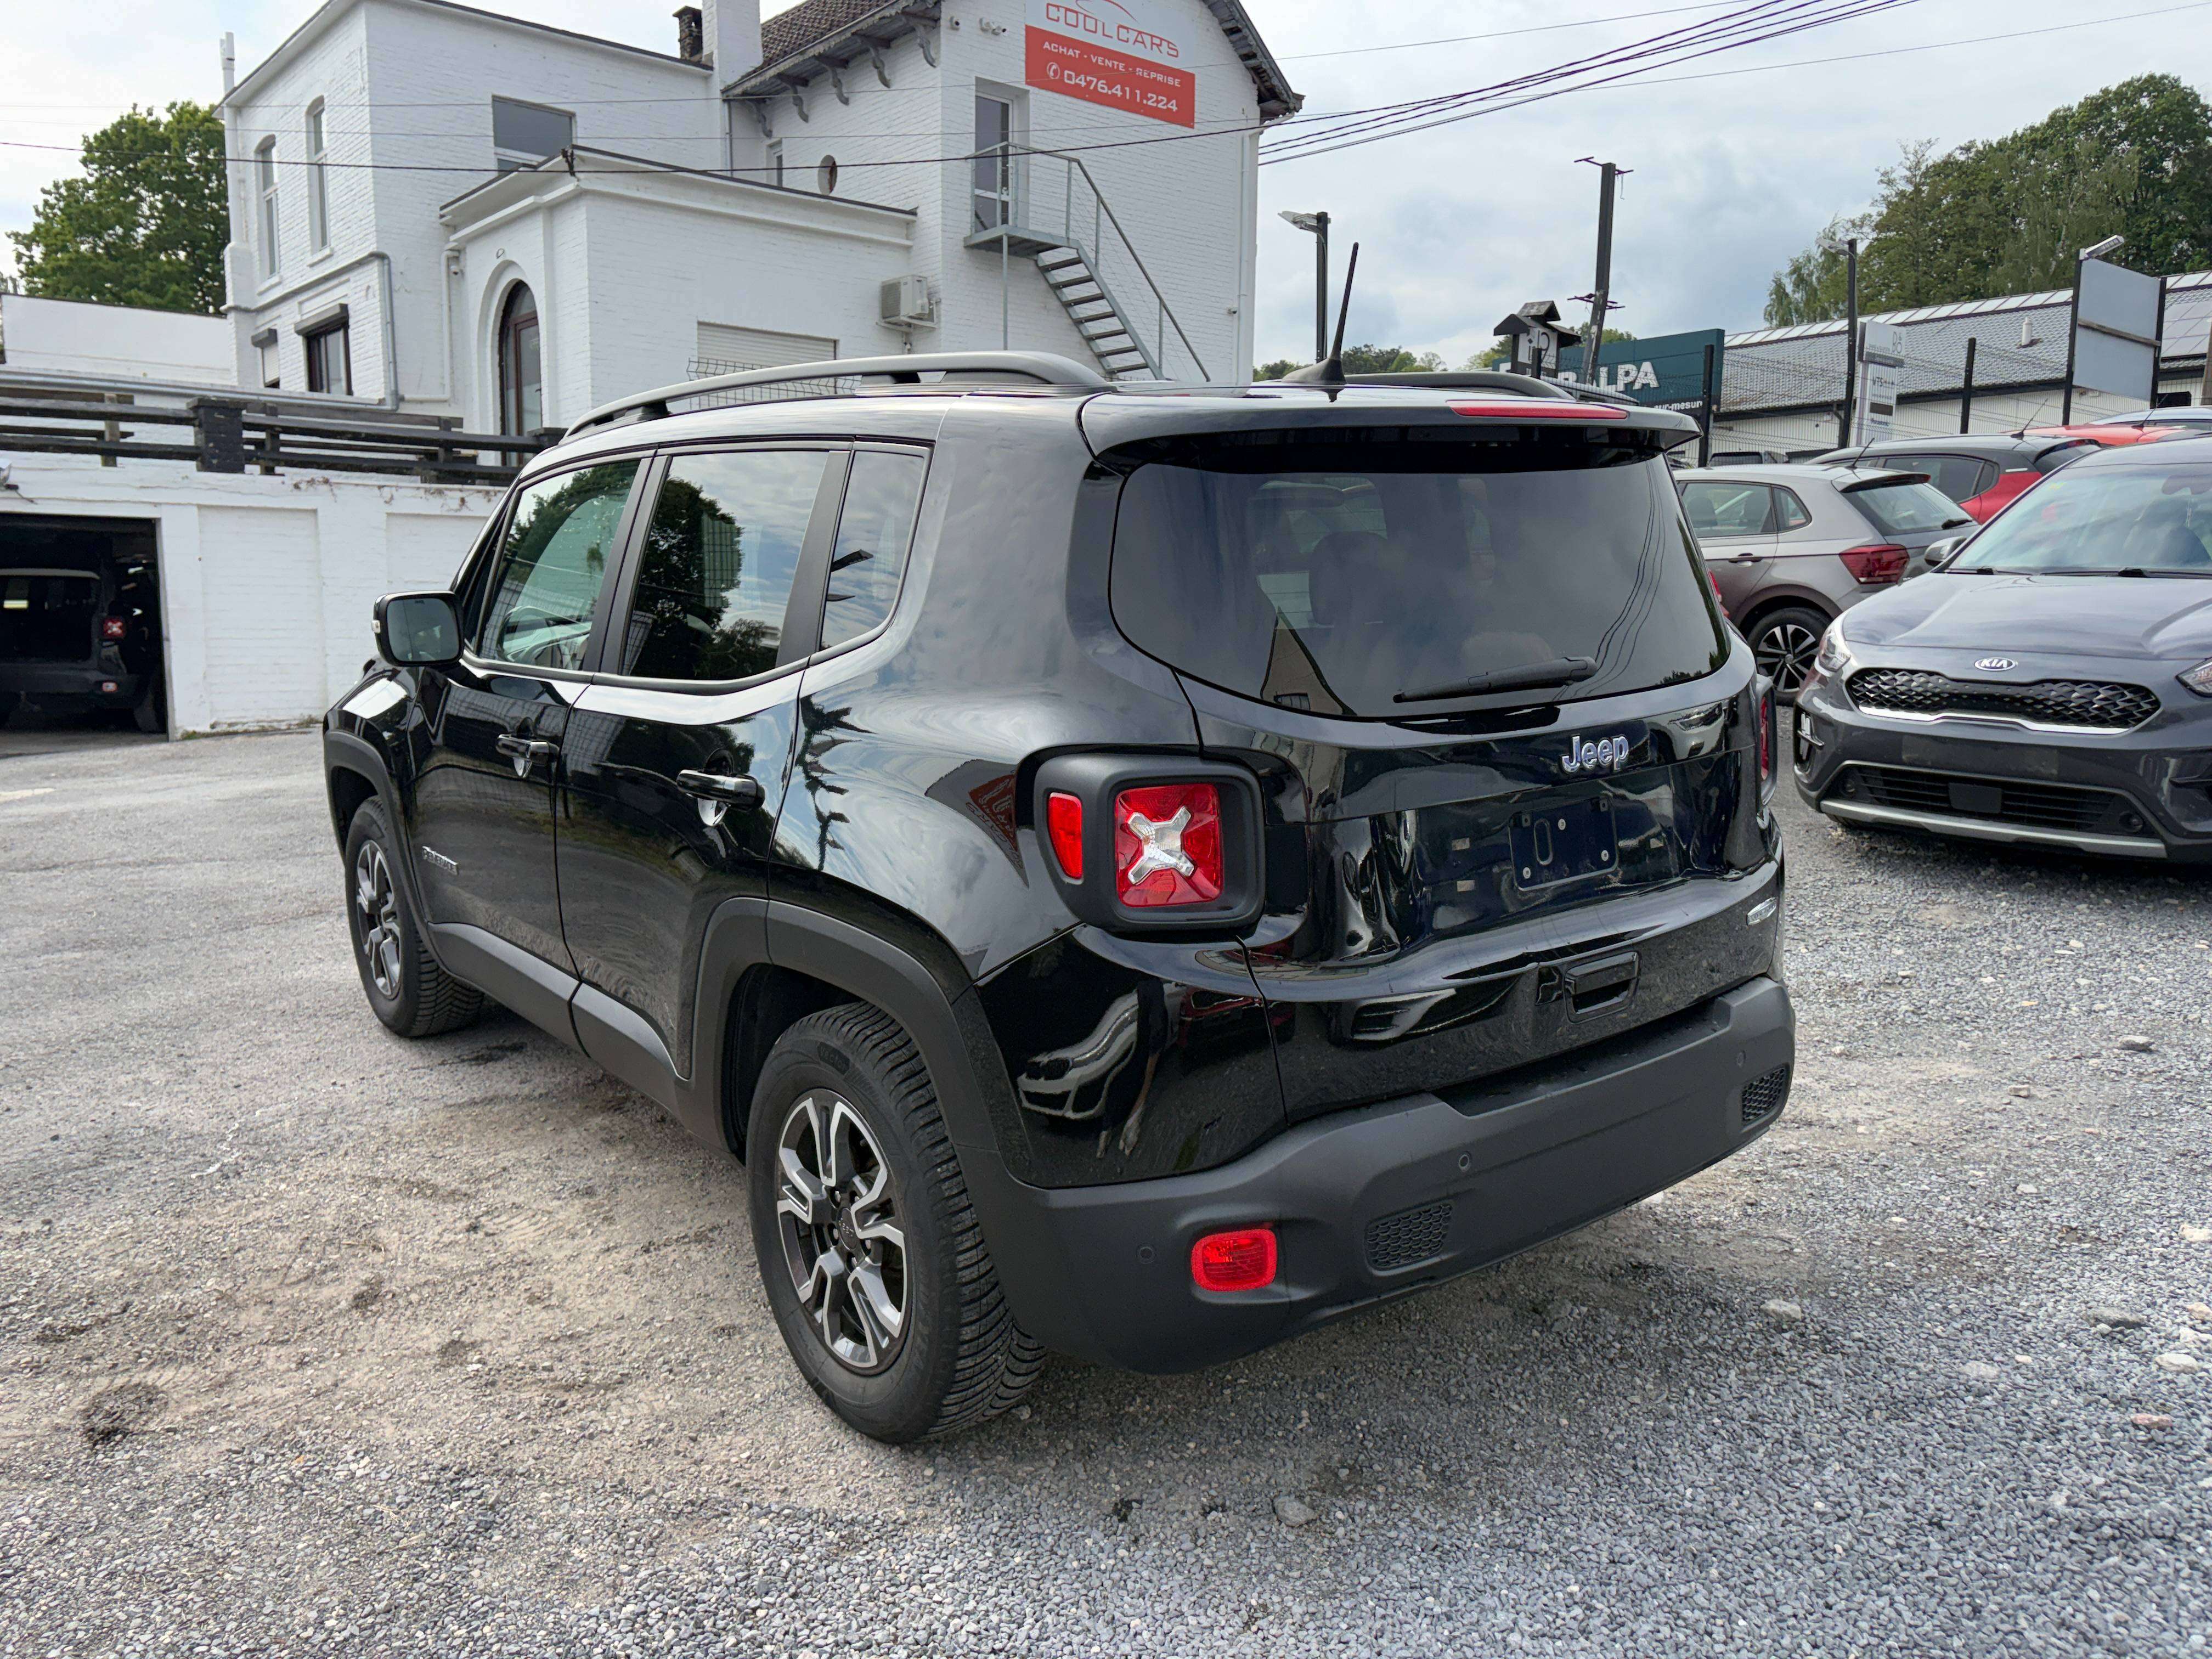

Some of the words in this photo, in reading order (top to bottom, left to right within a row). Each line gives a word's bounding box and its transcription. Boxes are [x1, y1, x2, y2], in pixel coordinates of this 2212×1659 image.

[1042, 41, 1081, 59] ACHAT
[1090, 54, 1126, 72] VENTE
[1136, 67, 1181, 87] REPRISE
[1063, 70, 1178, 112] 0476.411.224
[1979, 658, 2008, 668] KIA
[1561, 735, 1629, 774] Jeep
